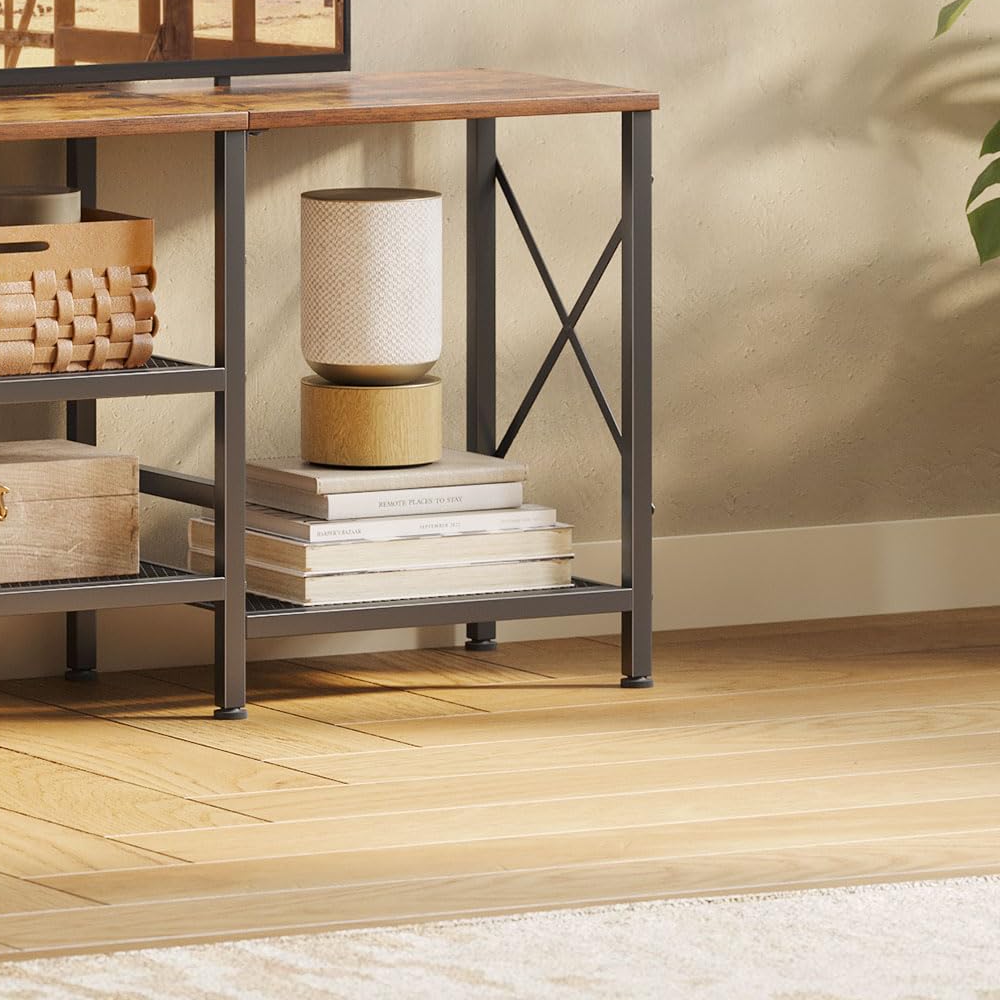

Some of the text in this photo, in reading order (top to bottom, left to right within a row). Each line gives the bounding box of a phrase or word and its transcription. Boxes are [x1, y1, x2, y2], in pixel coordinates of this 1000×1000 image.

[378, 496, 464, 508] REMOTE PLACES TO STAY
